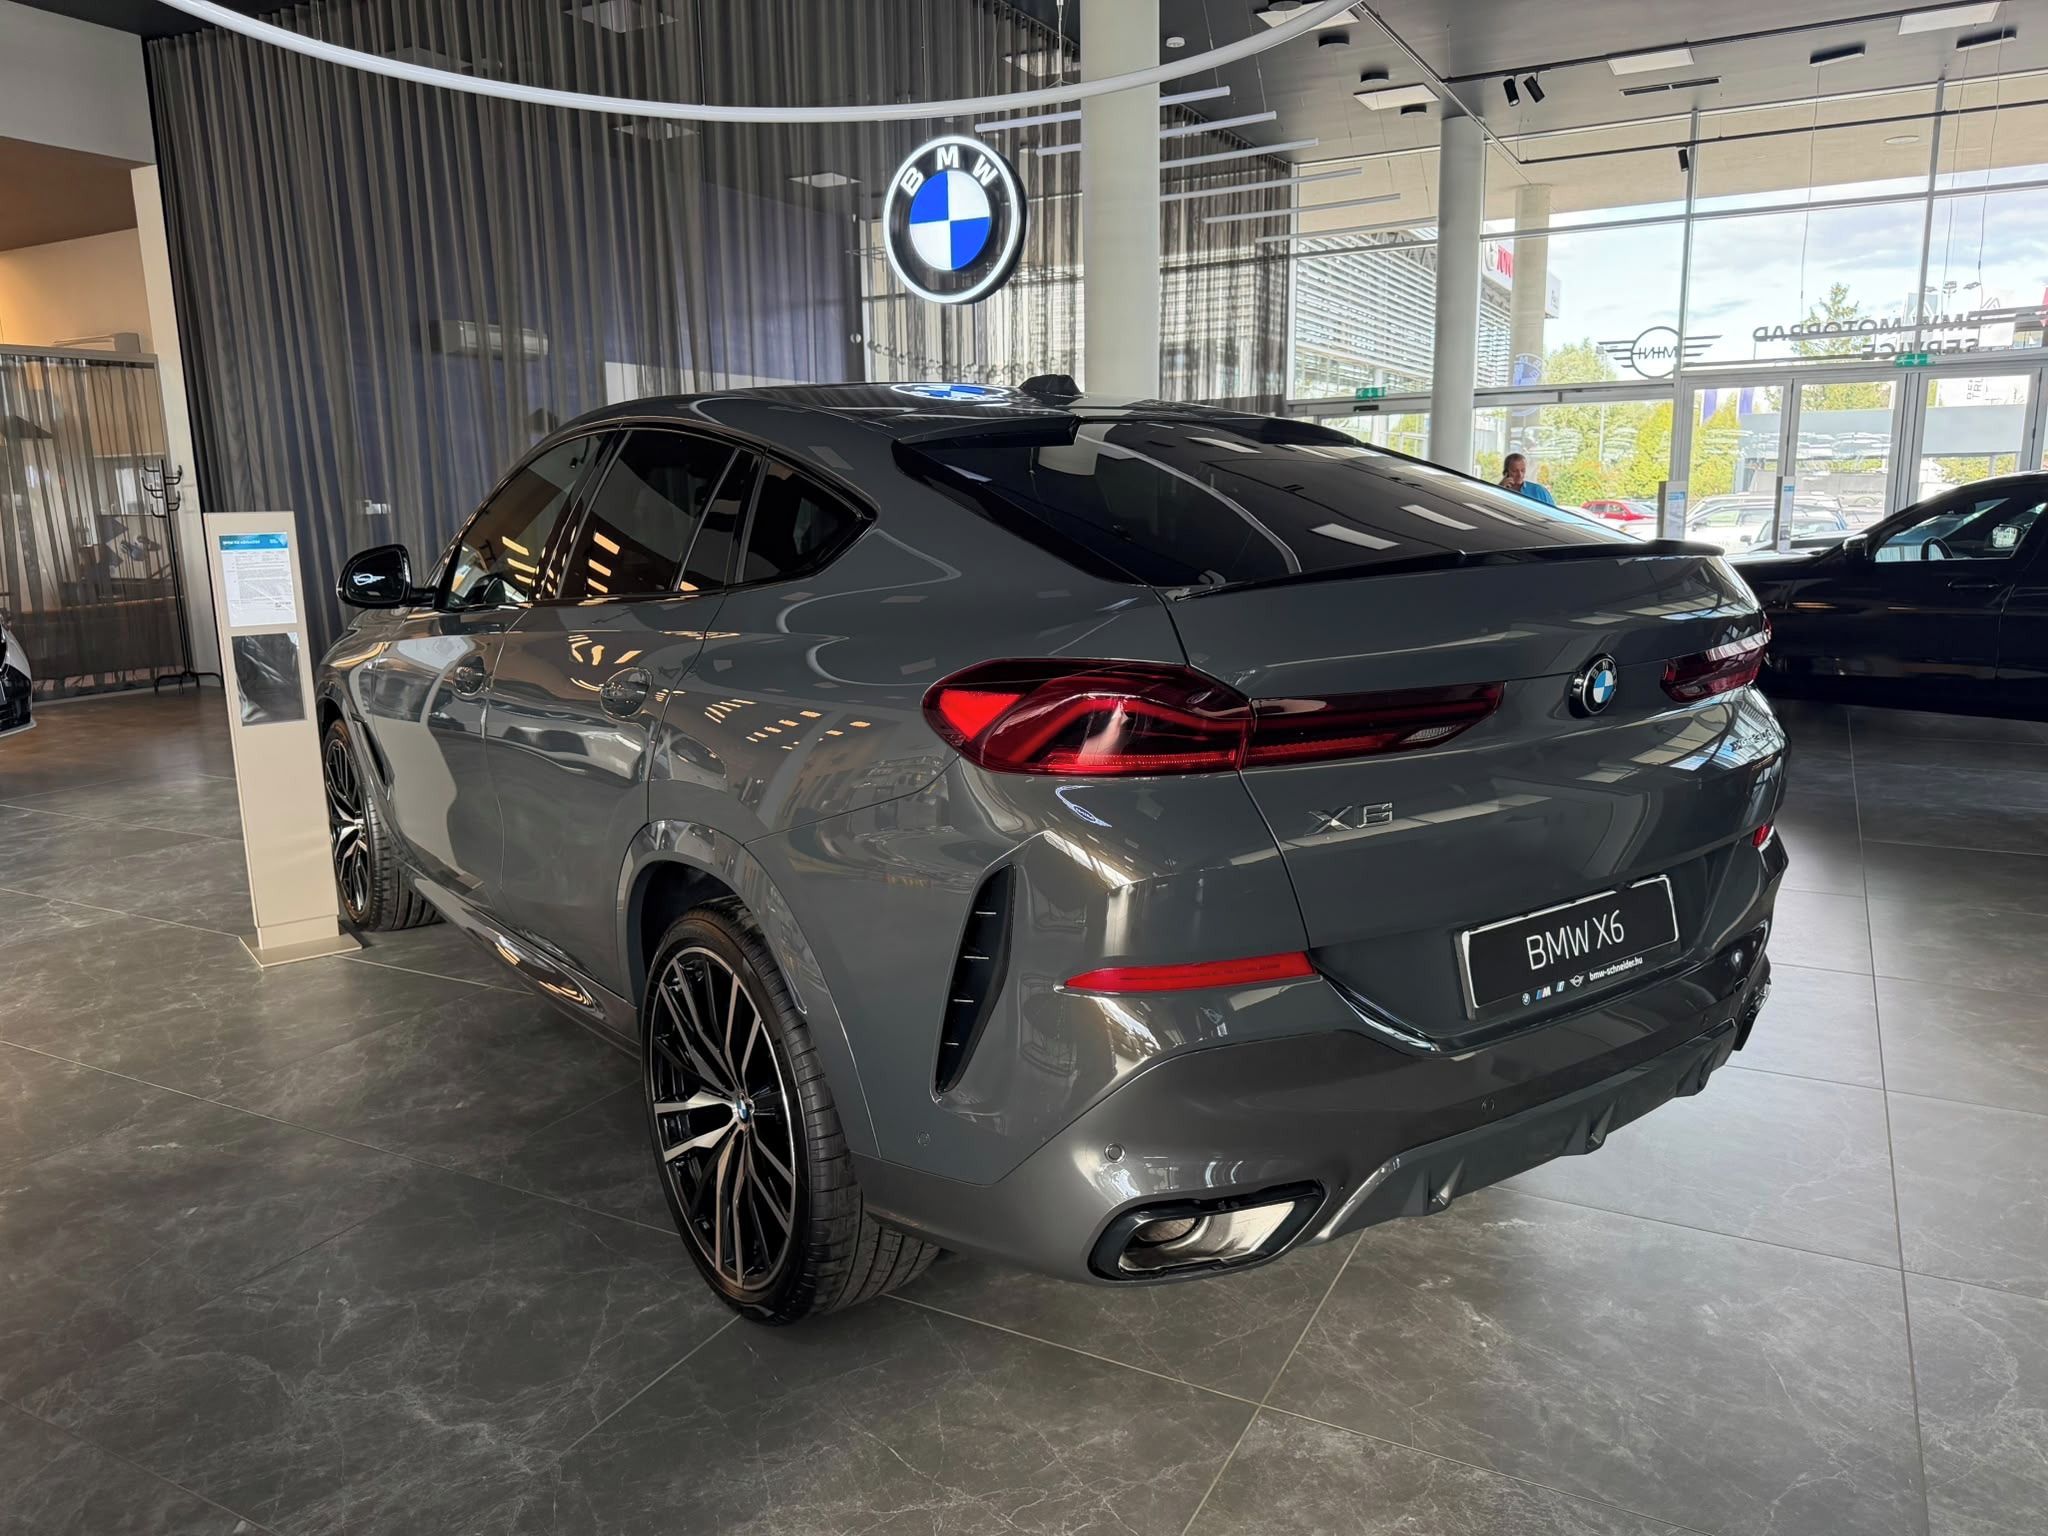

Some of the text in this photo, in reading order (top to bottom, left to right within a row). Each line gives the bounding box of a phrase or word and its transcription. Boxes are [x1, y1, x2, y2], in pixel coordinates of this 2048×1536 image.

[900, 145, 998, 197] BMW
[1304, 802, 1393, 836] X6
[1526, 909, 1625, 970] BMW X6
[1589, 956, 1643, 981] bmw-schneider.hu
